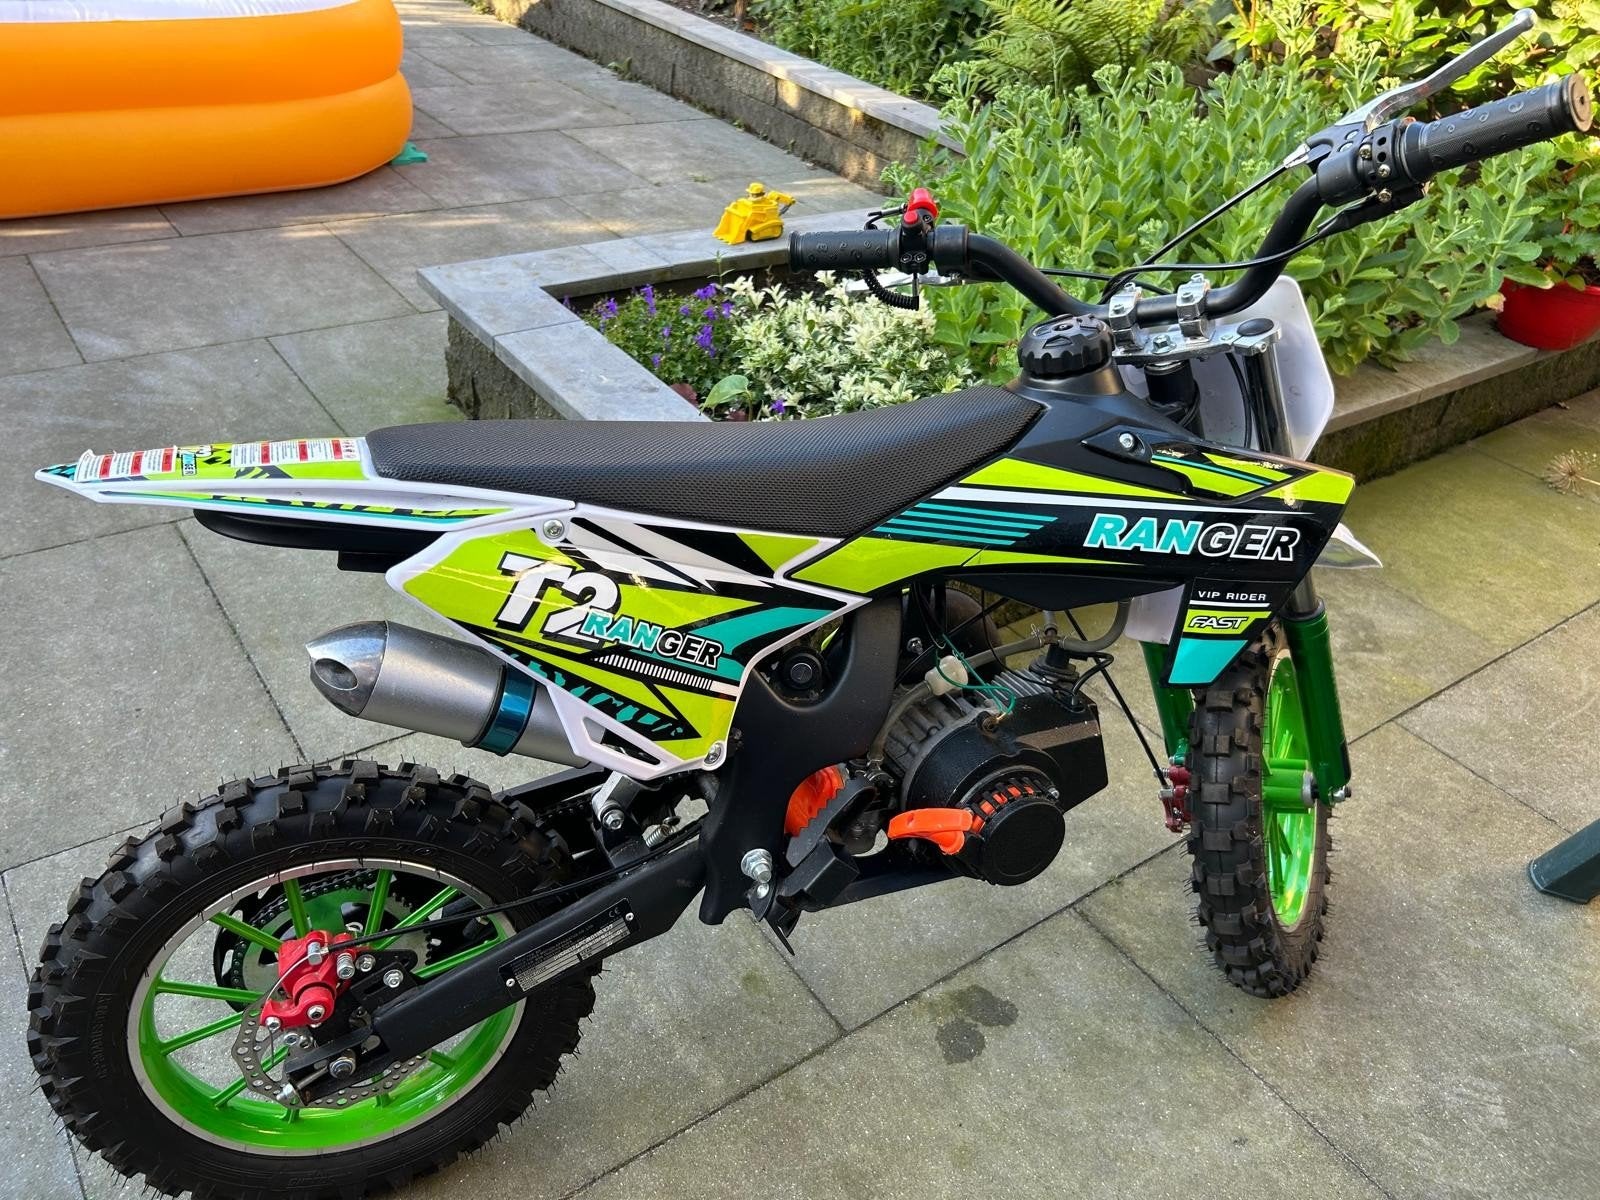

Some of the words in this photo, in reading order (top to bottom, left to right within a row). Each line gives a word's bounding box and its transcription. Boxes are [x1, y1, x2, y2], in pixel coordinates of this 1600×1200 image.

[1083, 513, 1301, 562] RANGER
[493, 551, 621, 650] T2
[1198, 590, 1221, 599] VIP
[1226, 591, 1267, 601] RIDER
[579, 609, 724, 669] RANGER
[1189, 616, 1249, 630] FAST
